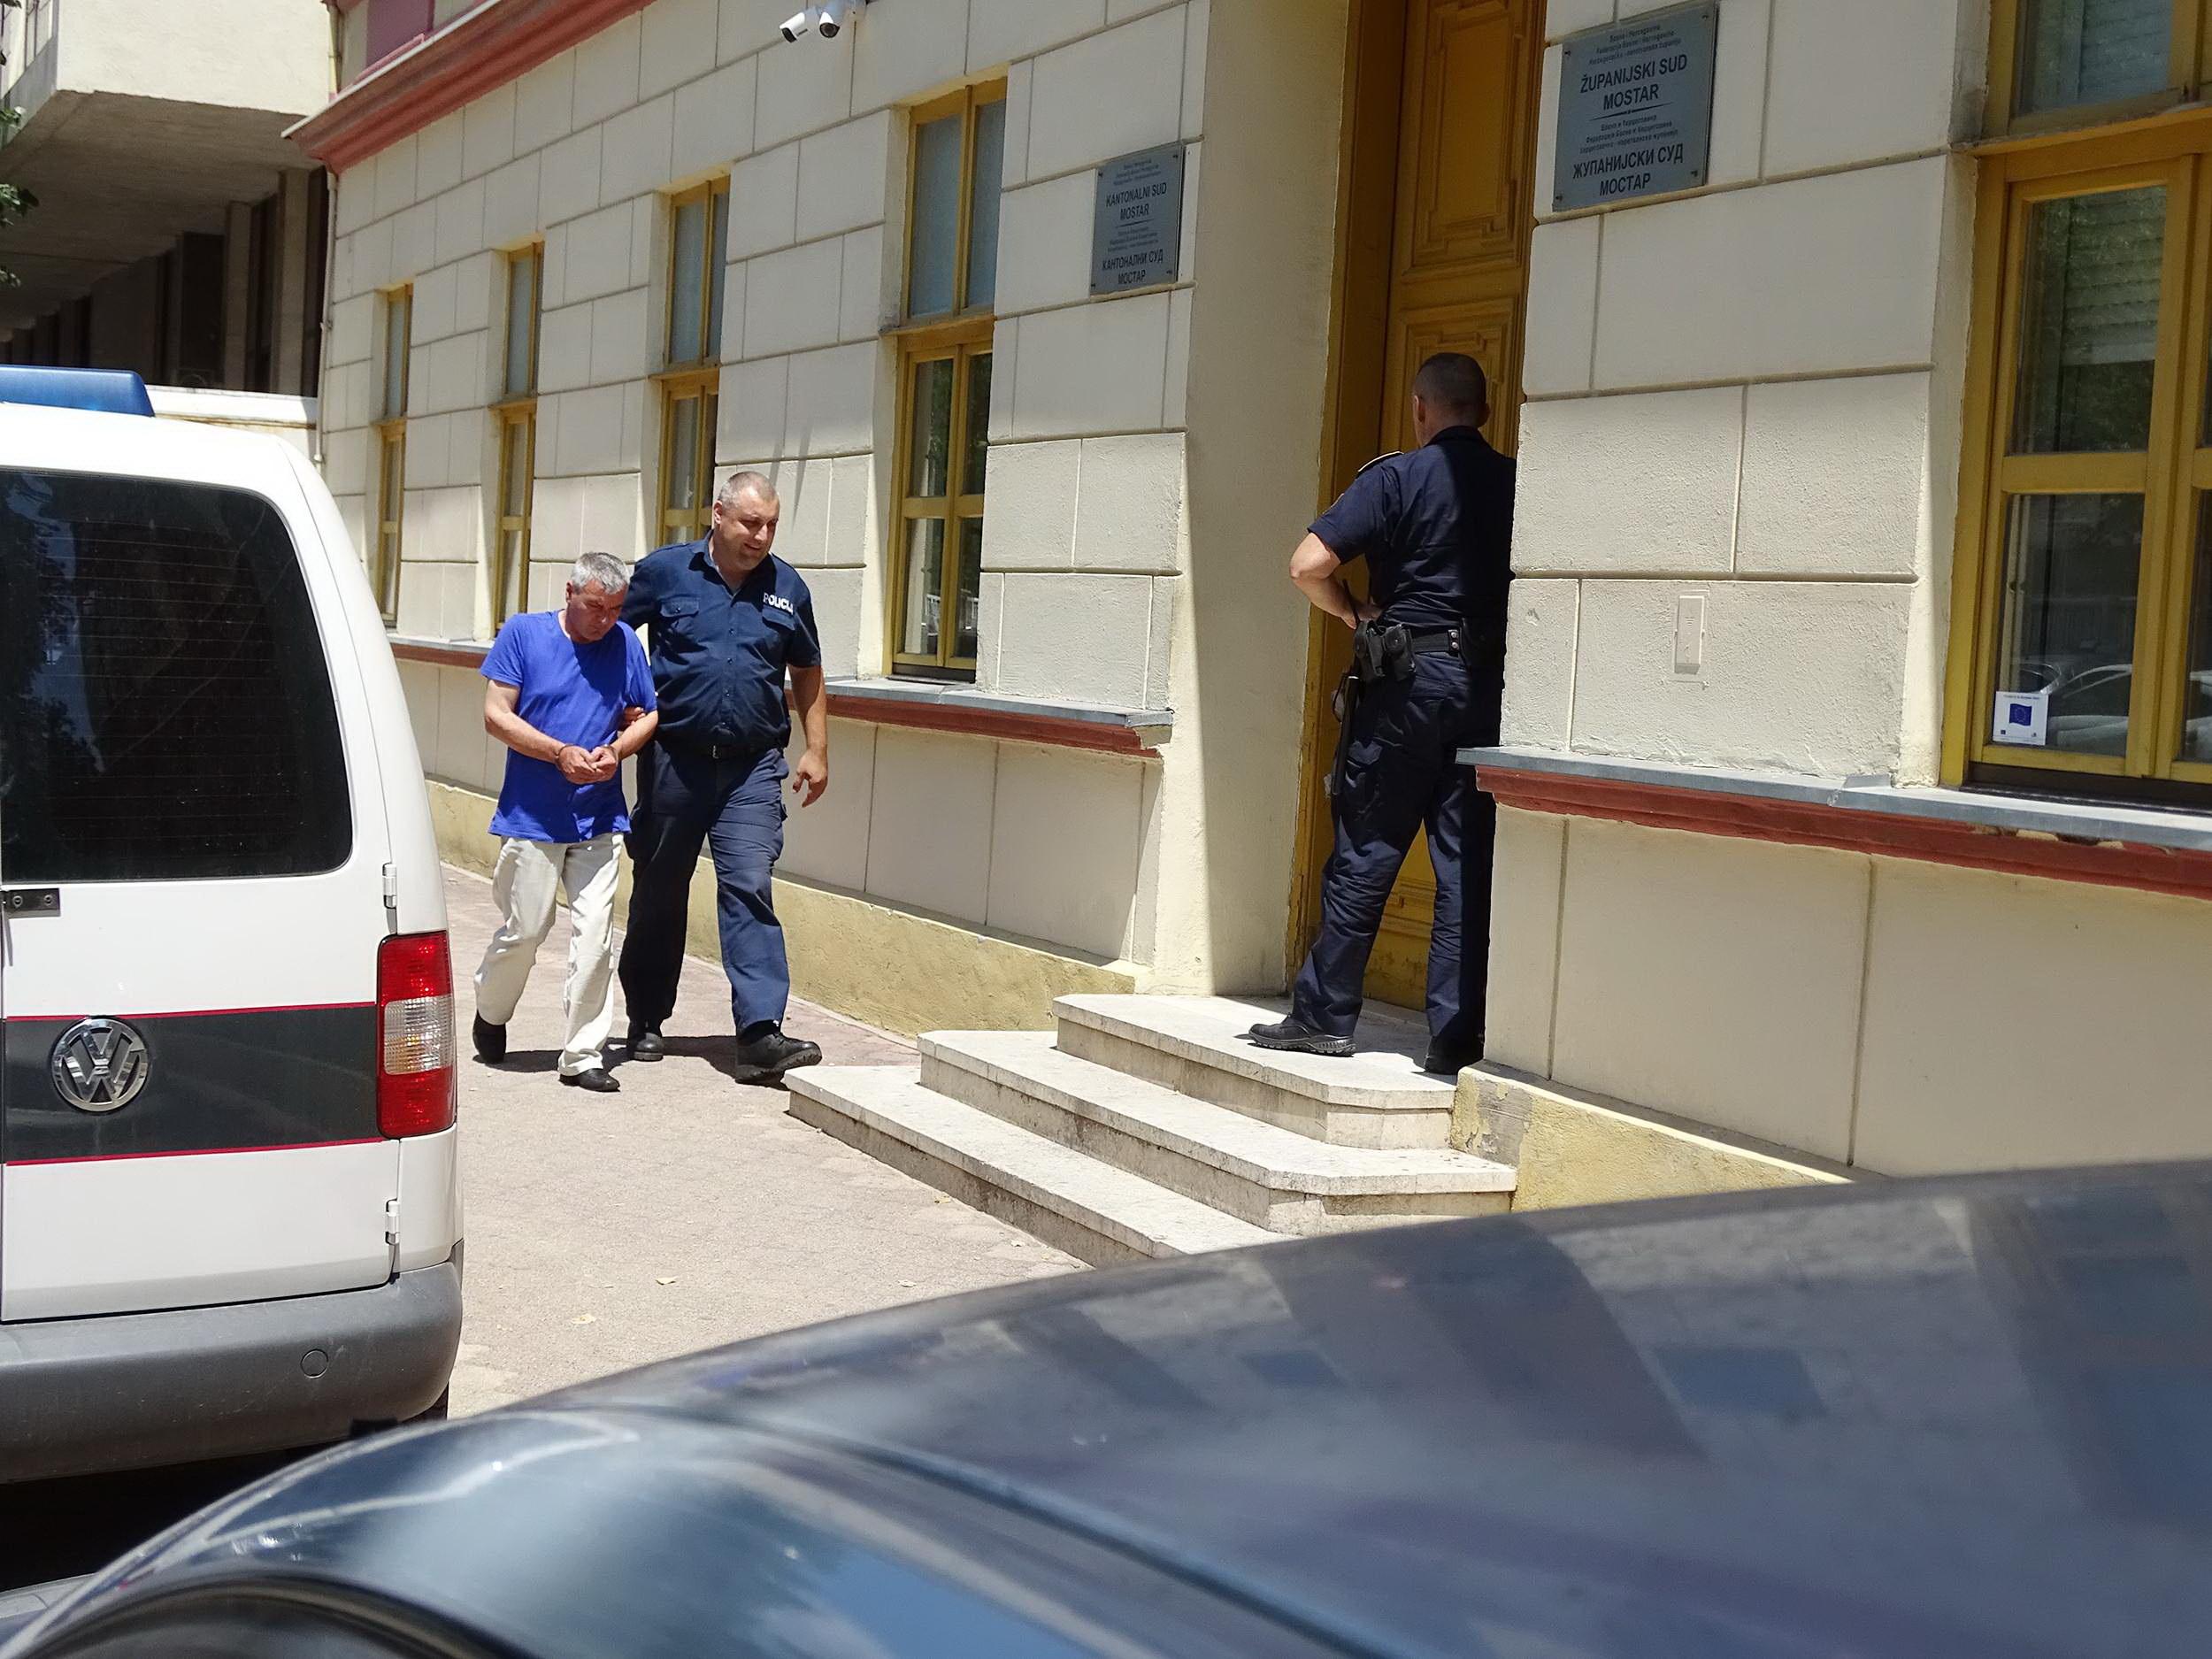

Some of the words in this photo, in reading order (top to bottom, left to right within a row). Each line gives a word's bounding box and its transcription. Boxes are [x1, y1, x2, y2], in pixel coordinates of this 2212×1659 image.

[1580, 61, 1655, 94] ŽUPANIJSKI
[1658, 54, 1688, 75] SUD
[1603, 83, 1659, 111] MOSTAR
[1573, 150, 1654, 179] ЖУПАНИЈСКИ
[1657, 143, 1684, 165] СУД
[1106, 185, 1150, 208] KANTONALNI
[1152, 182, 1167, 196] SUD
[1600, 173, 1652, 196] МОСТАР
[1120, 204, 1149, 221] MOSTAR
[1102, 253, 1148, 272] КАНТОНАЛНИ
[1148, 249, 1164, 265] СУД
[1118, 270, 1147, 285] МОСТАР
[53, 1018, 148, 1111] VW
